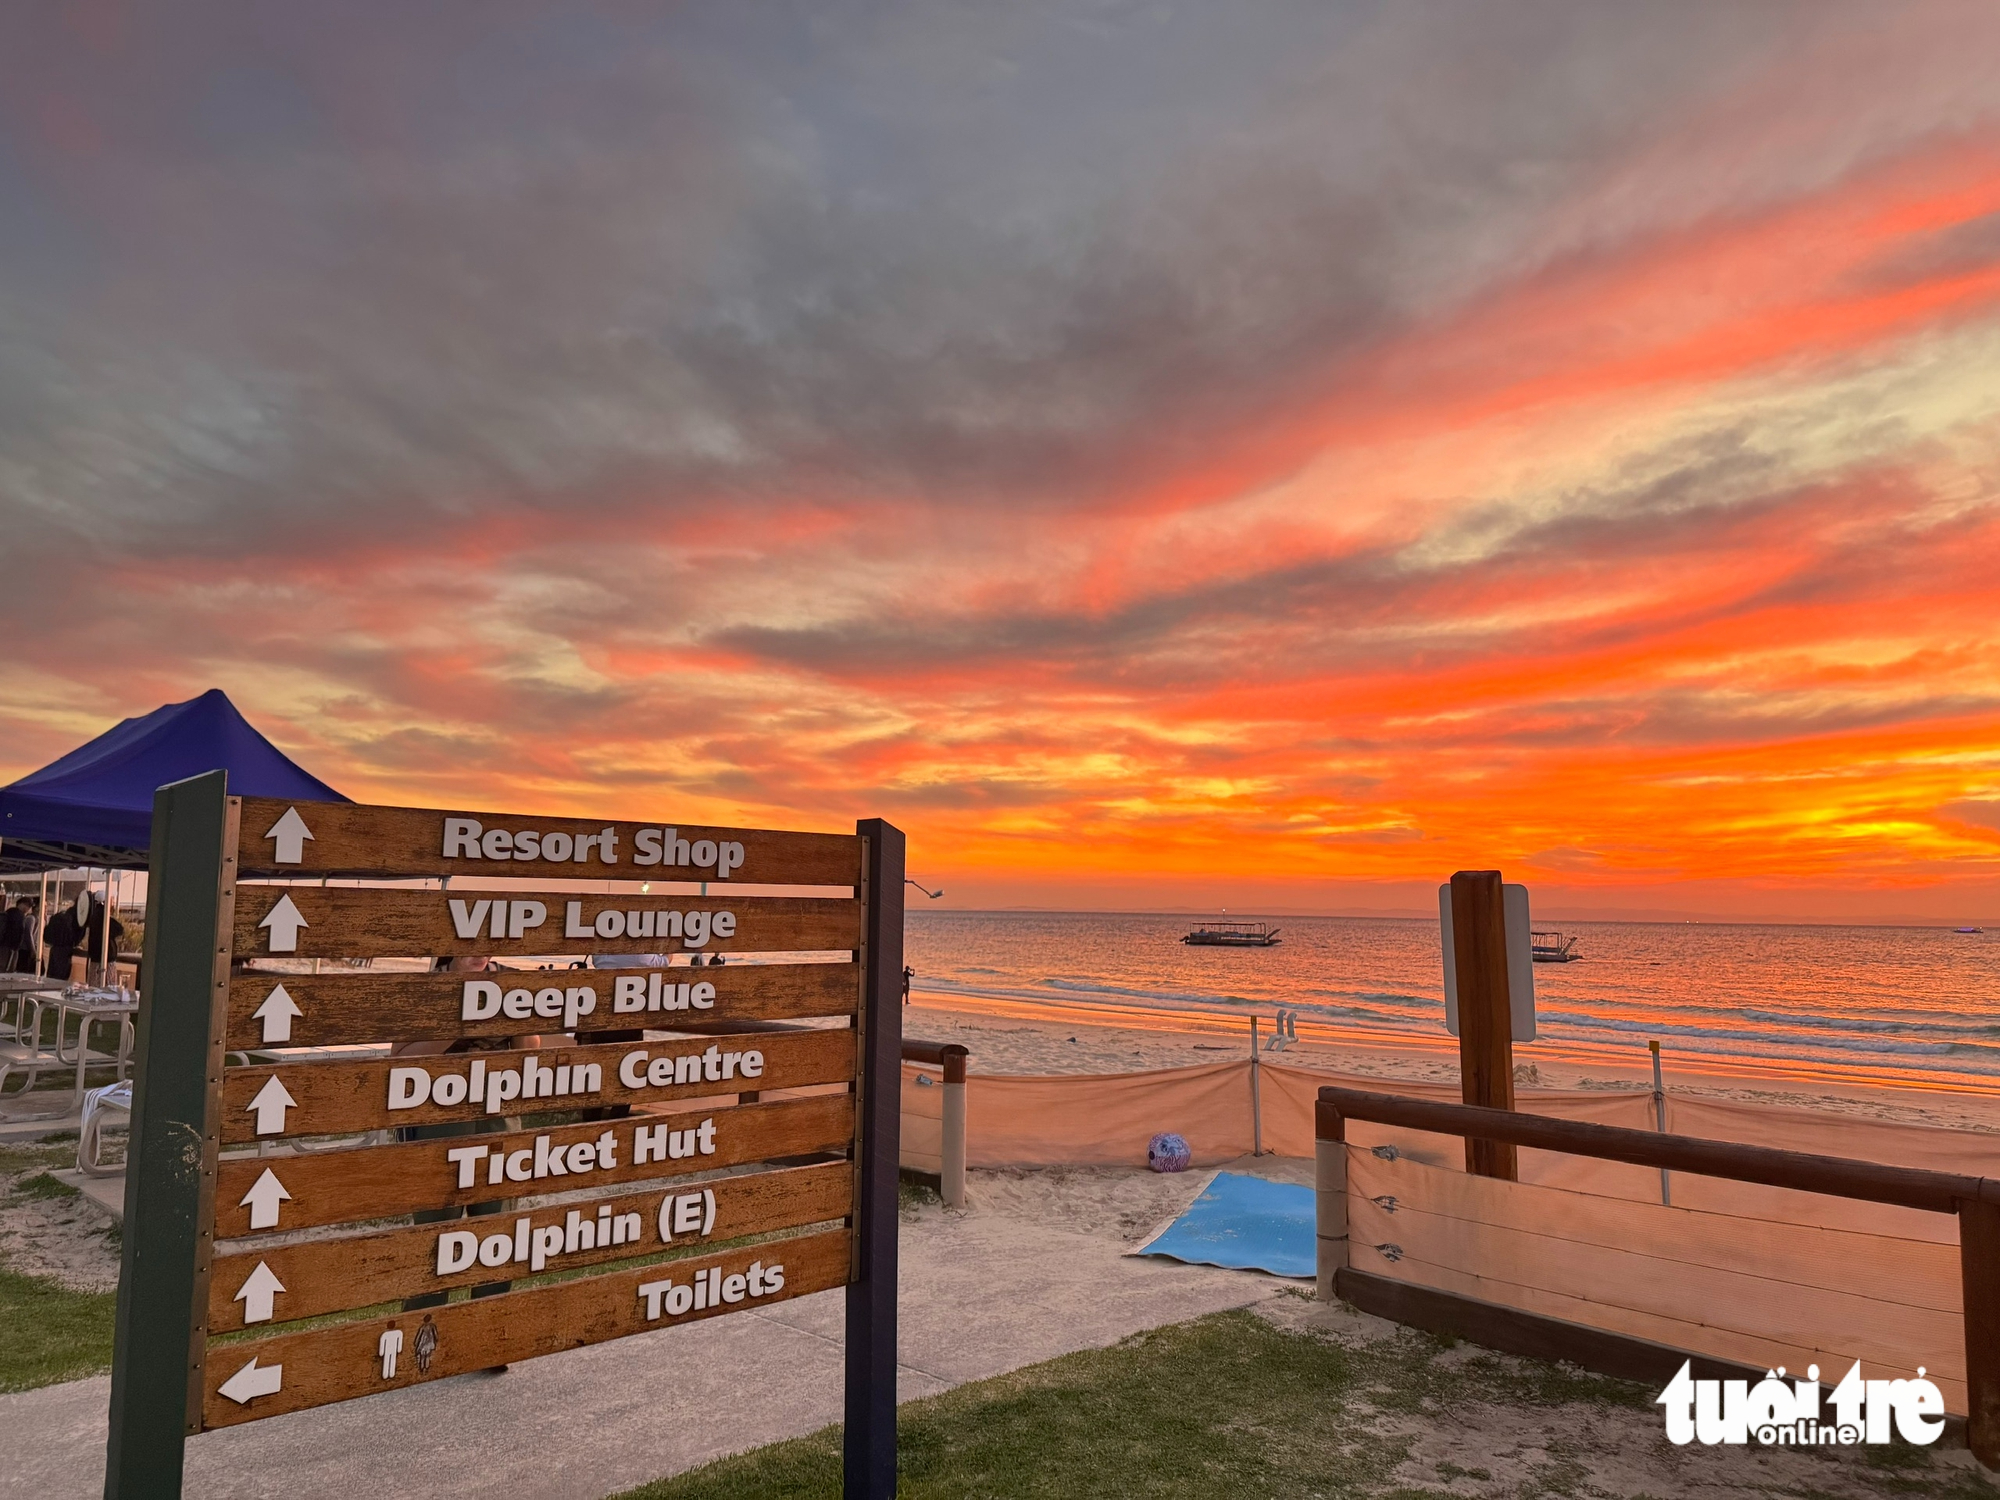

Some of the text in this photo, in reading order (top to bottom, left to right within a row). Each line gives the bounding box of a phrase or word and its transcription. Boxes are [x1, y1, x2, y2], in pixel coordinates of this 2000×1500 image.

[443, 817, 746, 878] Resort Shop
[448, 899, 737, 948] VIP Lounge
[462, 973, 716, 1028] Deep Blue
[388, 1045, 764, 1114] Dolphin Centre
[448, 1119, 717, 1188] Ticket Hut
[437, 1189, 717, 1275] Dolphin (E)
[638, 1260, 785, 1321] Toilets
